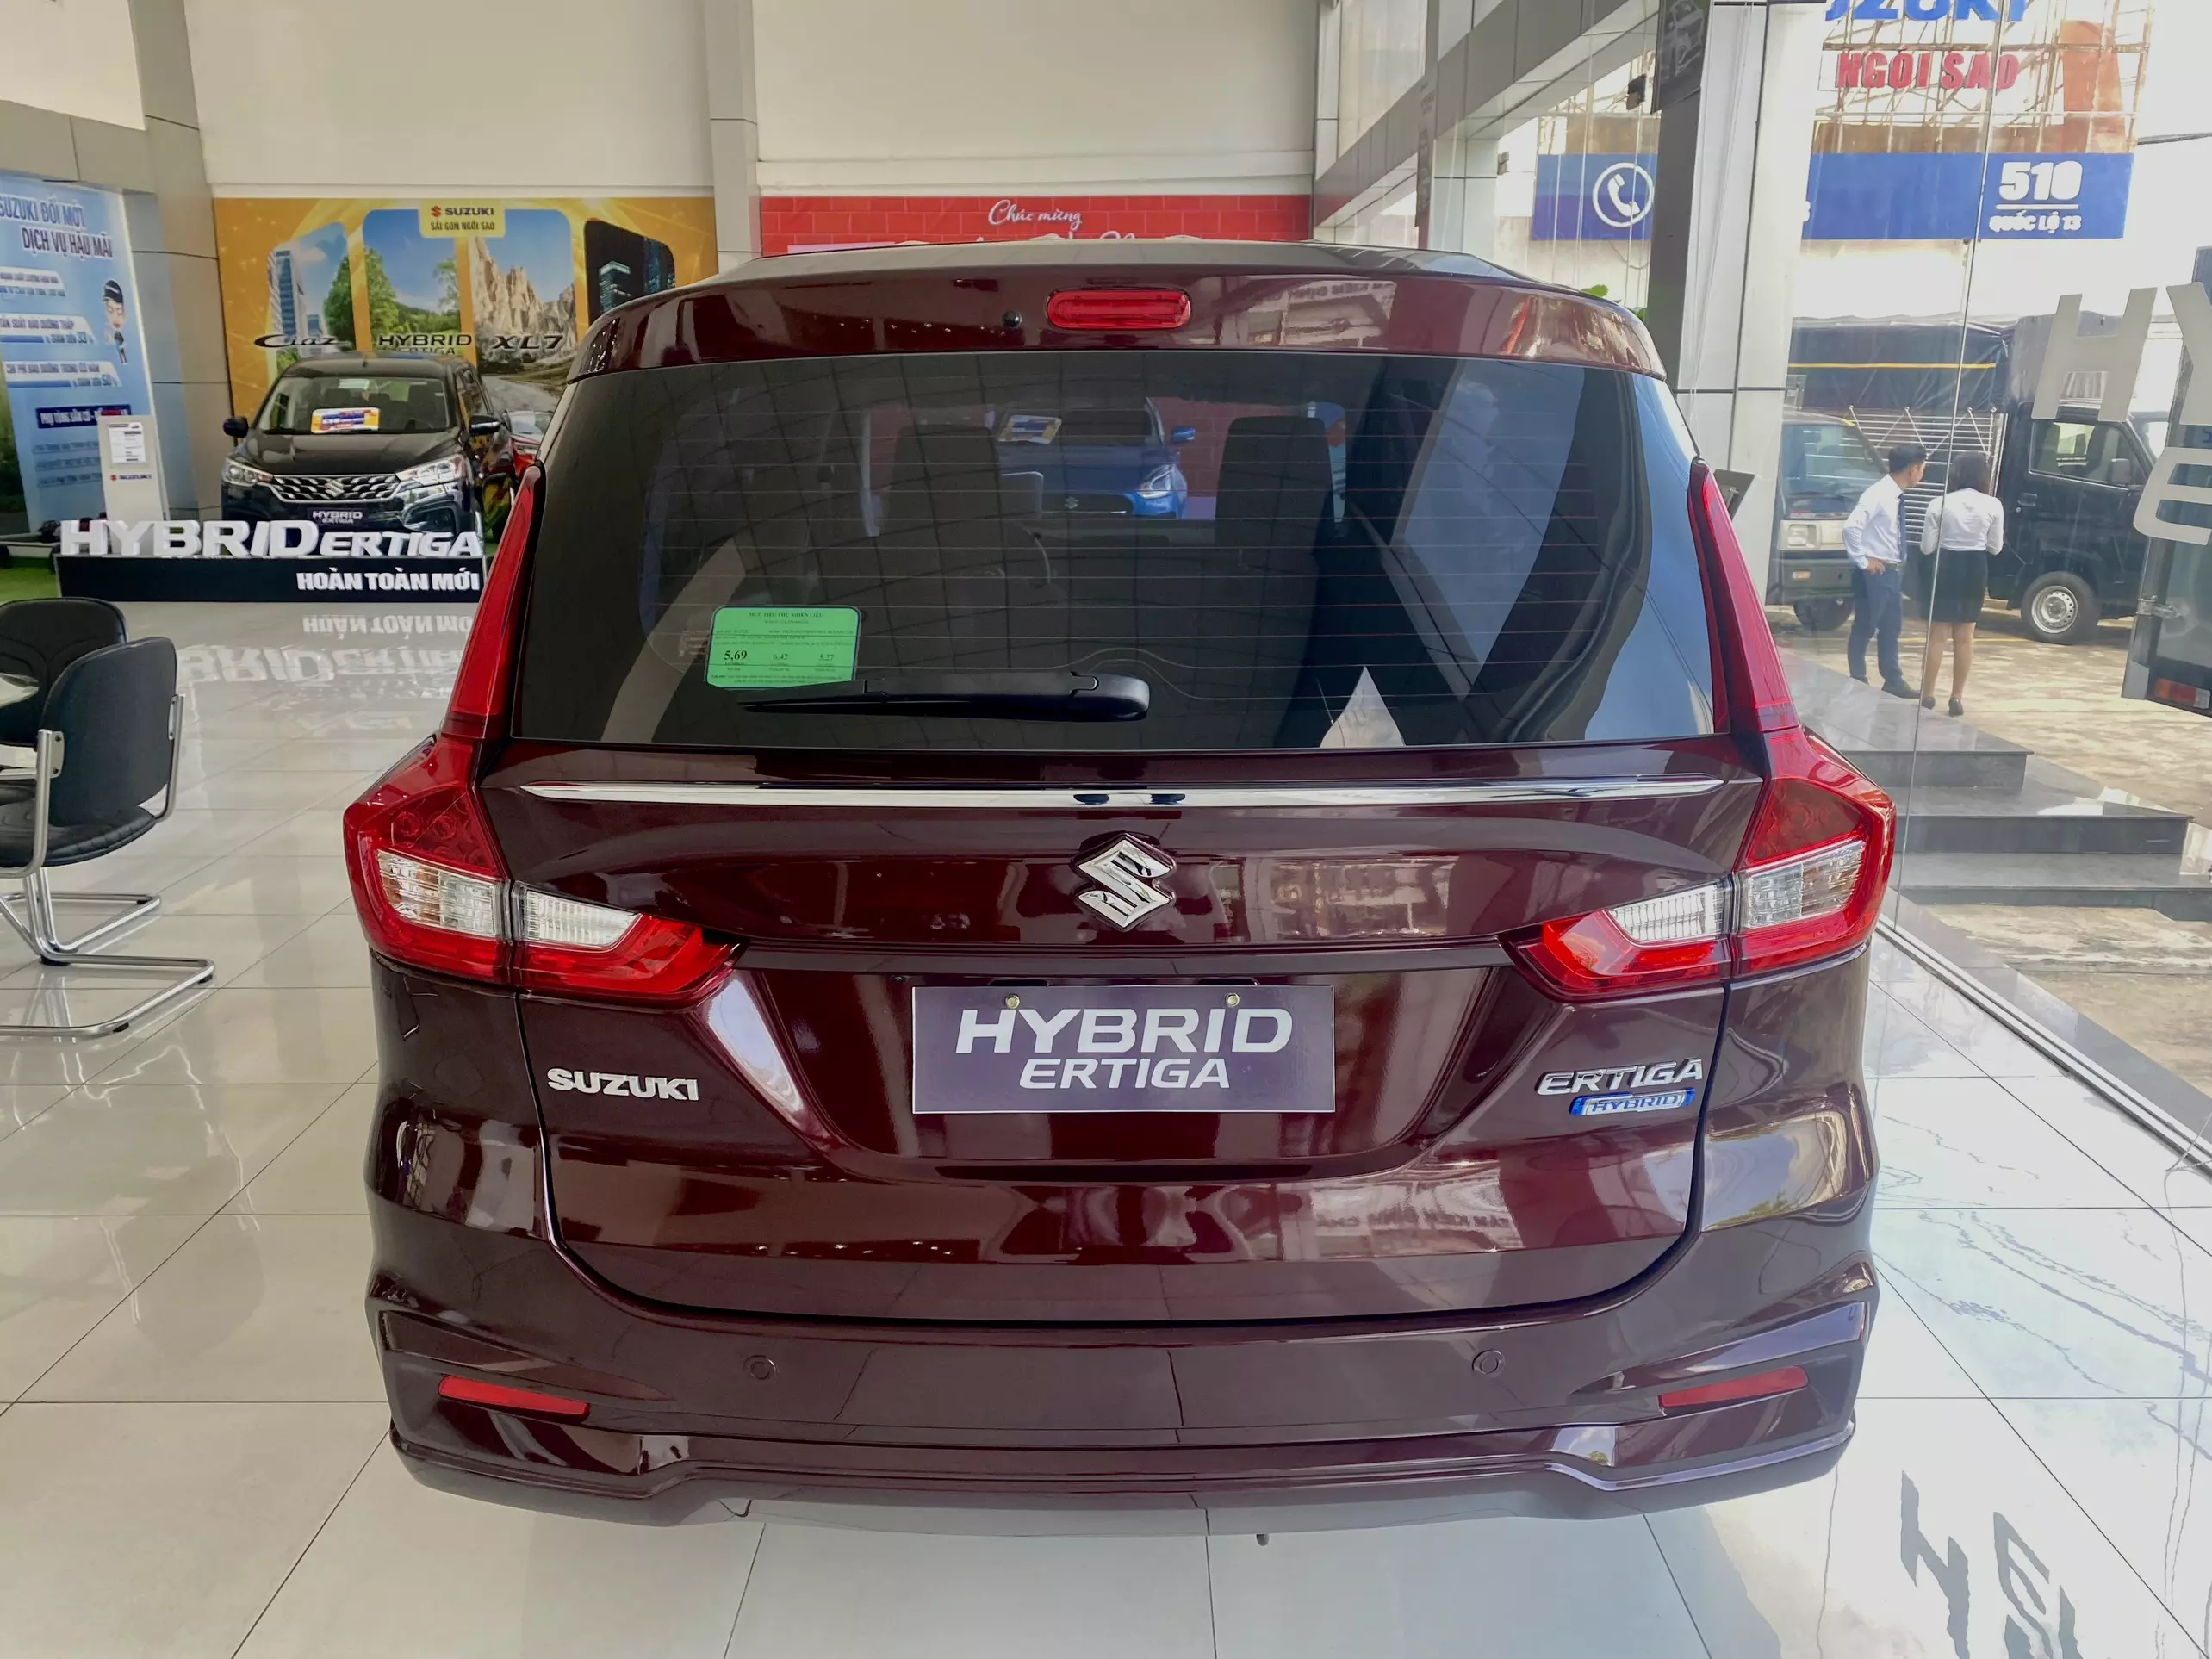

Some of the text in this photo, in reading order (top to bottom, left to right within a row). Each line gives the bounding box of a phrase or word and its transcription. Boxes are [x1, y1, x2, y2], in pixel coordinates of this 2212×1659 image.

[1942, 52, 2020, 90] SAO
[1998, 161, 2083, 201] 510
[445, 207, 494, 216] SUZUKI
[988, 199, 1034, 225] Chúc
[379, 334, 472, 346] HYBRID
[493, 335, 563, 349] XL7
[312, 511, 363, 519] HYBRID
[60, 519, 319, 556] HYBRID
[319, 531, 482, 557] ERTIGA
[296, 567, 481, 591] HOÀN TOÀN MỚI
[724, 650, 748, 661] 5,69
[956, 1008, 1293, 1053] HYBRID
[547, 1068, 699, 1101] SUZUKI
[1019, 1058, 1230, 1089] ERTIGA
[1534, 1057, 1704, 1096] ERTIGA
[1591, 1093, 1680, 1112] HYBRID
